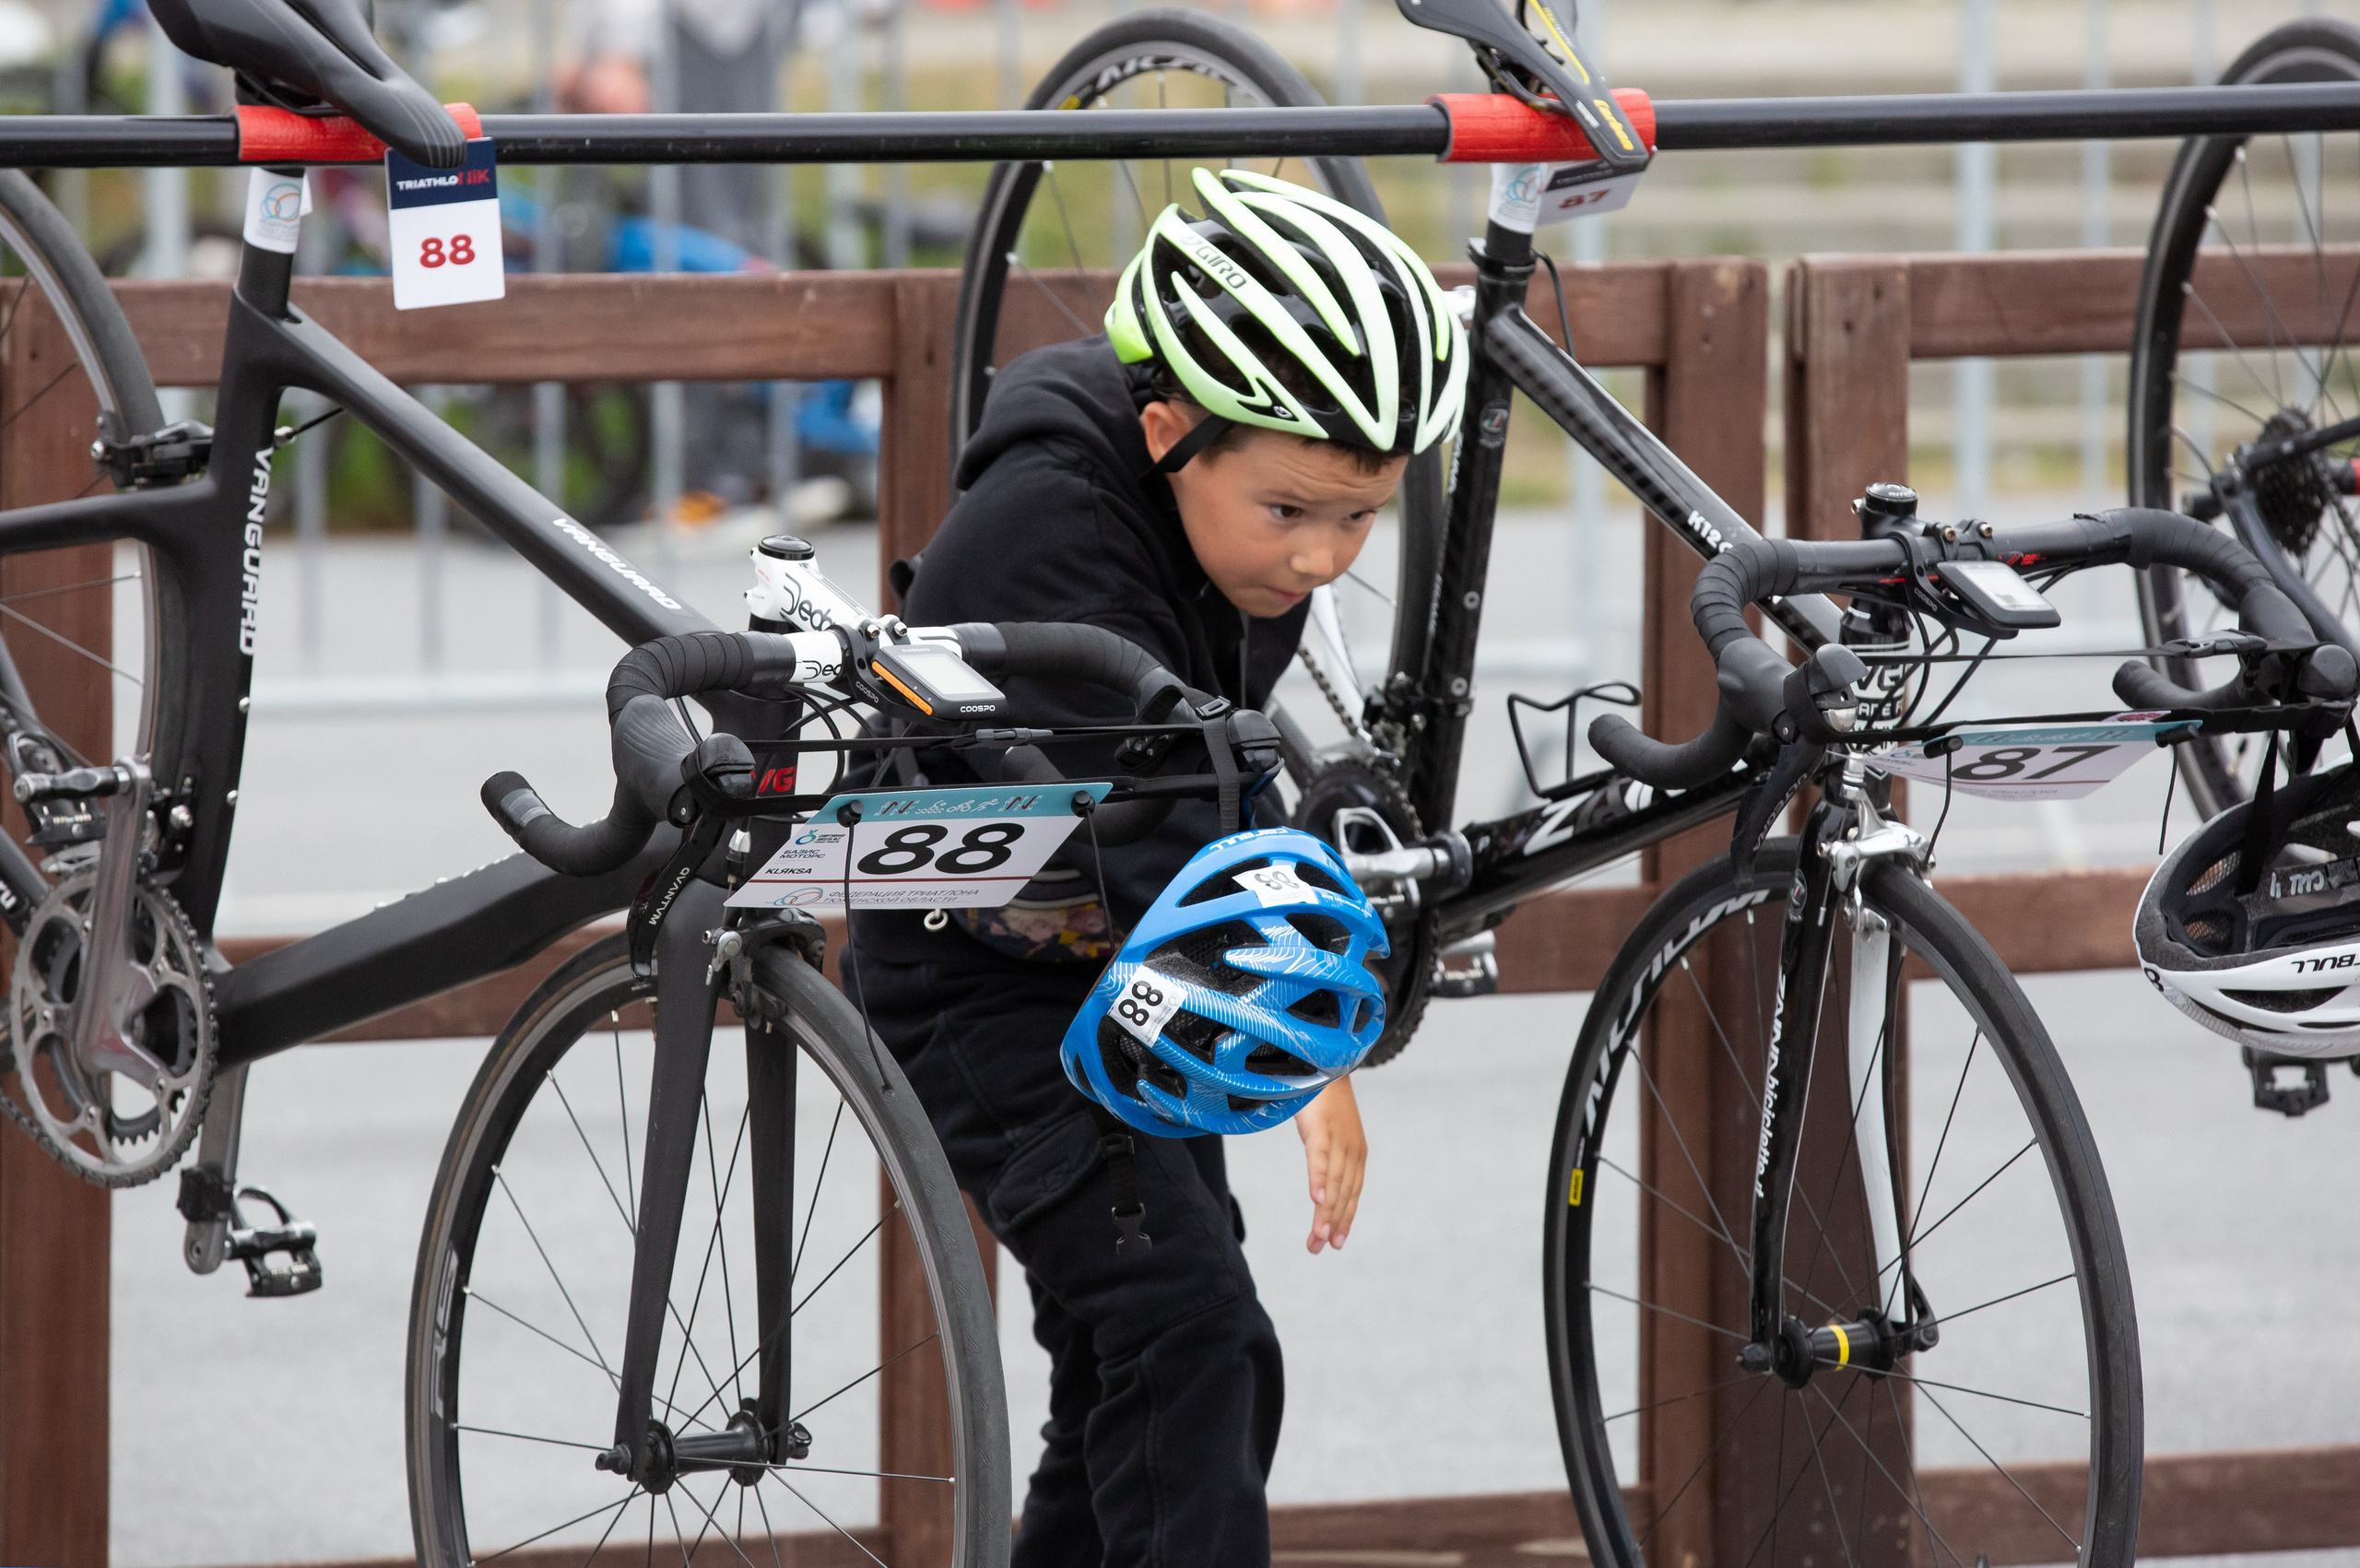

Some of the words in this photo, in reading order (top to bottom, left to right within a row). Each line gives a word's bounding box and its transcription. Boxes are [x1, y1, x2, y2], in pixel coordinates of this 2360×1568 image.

[419, 233, 476, 269] 88
[1196, 246, 1247, 289] GIRO
[239, 446, 274, 656] VANGUARD
[553, 517, 682, 610] VANGUARD
[856, 680, 879, 704] COOSPO
[960, 704, 997, 713] COOSPO
[1951, 745, 2121, 781] 87
[856, 822, 1026, 876] 88
[2290, 953, 2360, 974] BULL
[1117, 980, 1164, 1027] 88
